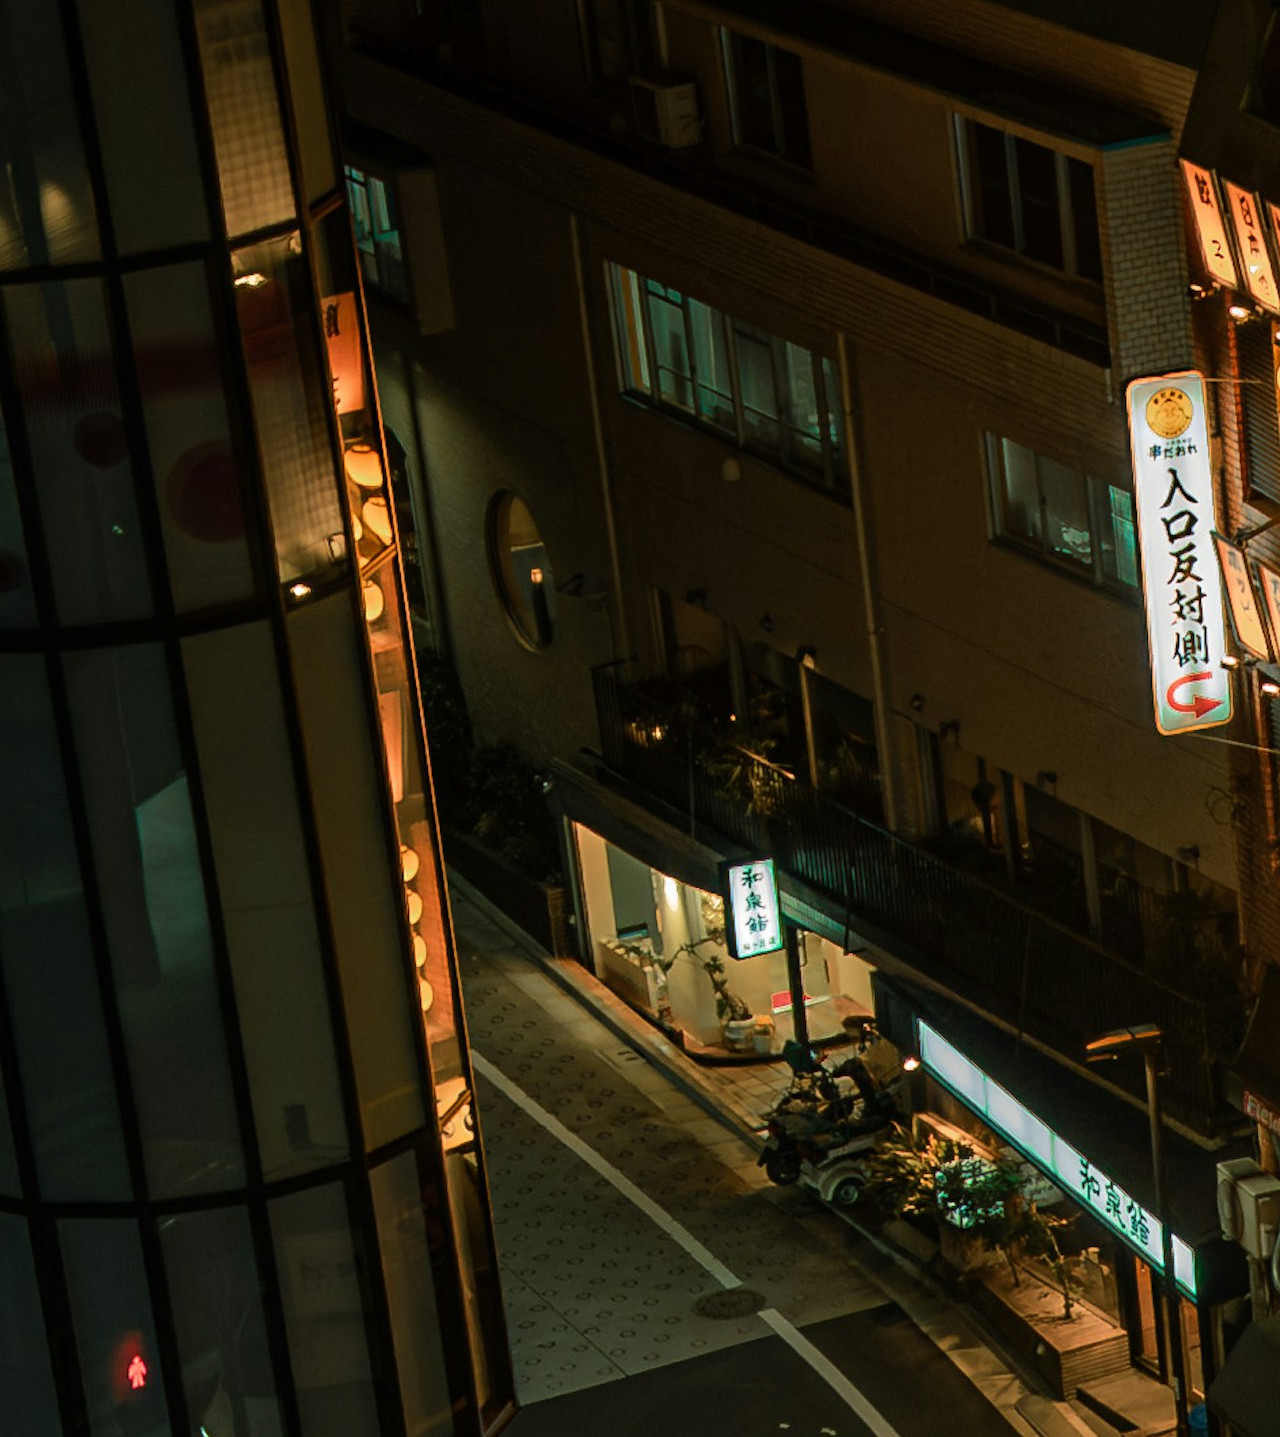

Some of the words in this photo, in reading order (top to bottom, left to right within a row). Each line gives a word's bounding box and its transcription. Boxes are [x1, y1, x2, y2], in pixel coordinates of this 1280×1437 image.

[1160, 466, 1210, 668] 入口反対側
